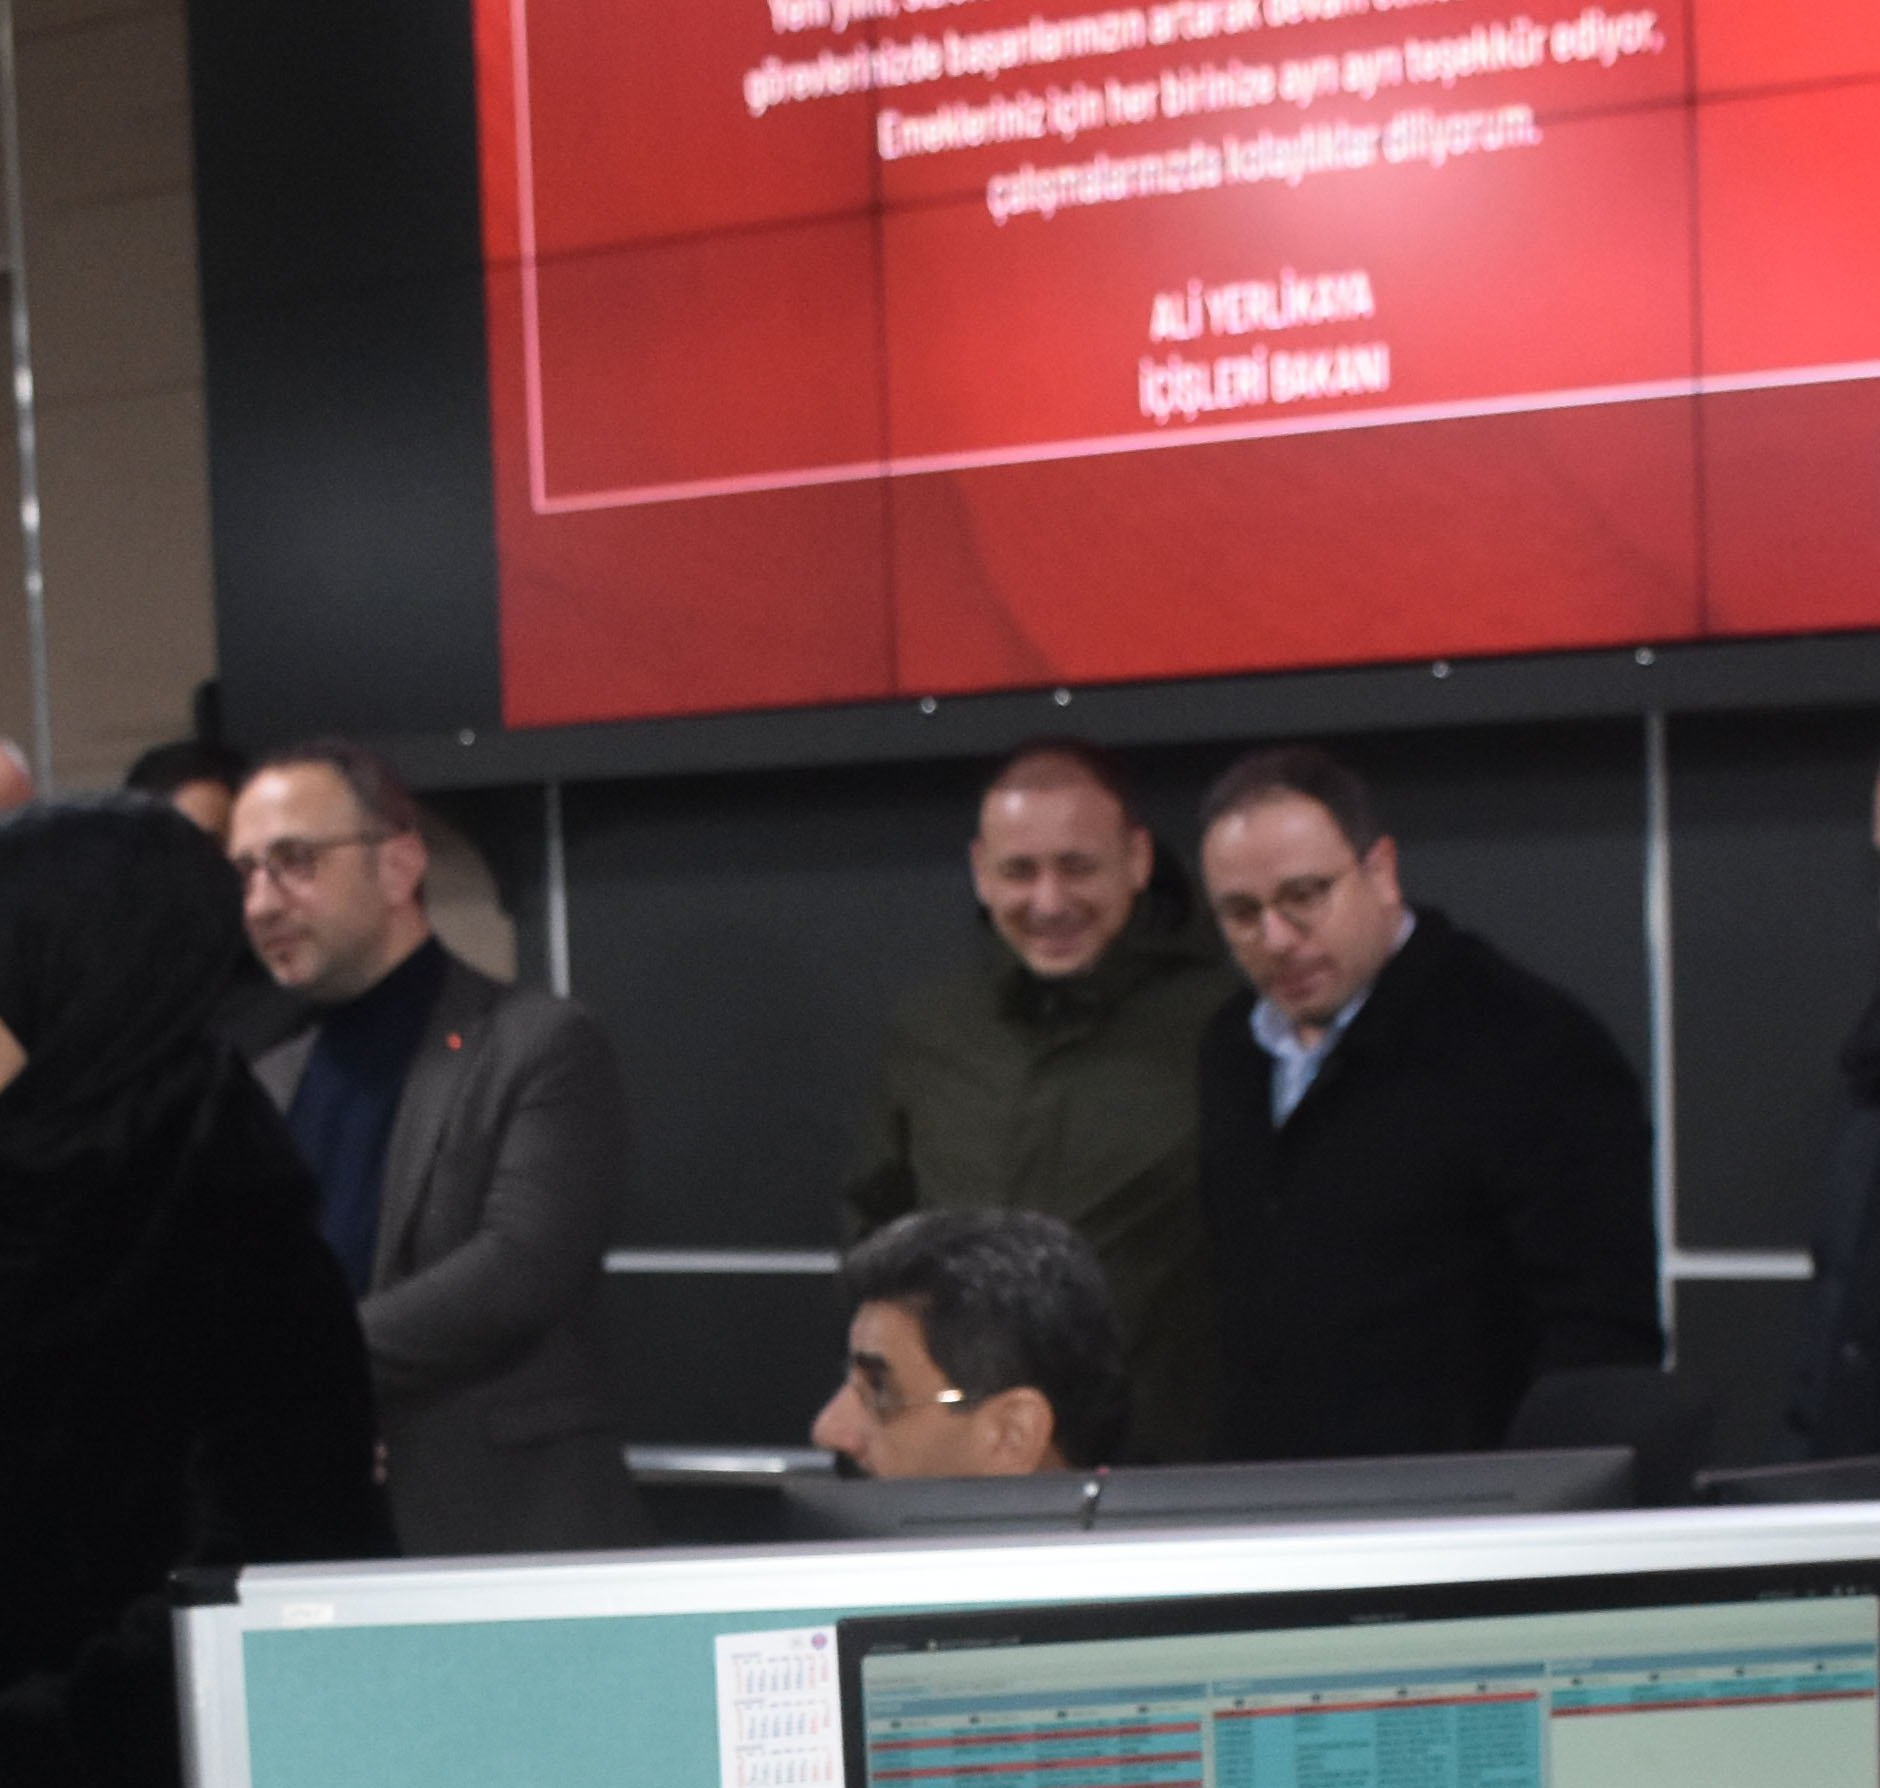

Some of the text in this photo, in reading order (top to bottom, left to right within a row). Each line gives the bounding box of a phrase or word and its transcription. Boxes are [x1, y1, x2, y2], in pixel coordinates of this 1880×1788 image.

[1046, 81, 1104, 142] için
[1105, 77, 1157, 126] her
[1404, 14, 1548, 90] teşekkür
[1149, 264, 1376, 343] ALİ YERLİKAYA
[1138, 340, 1391, 426] İÇİŞLERİ BAKANI
